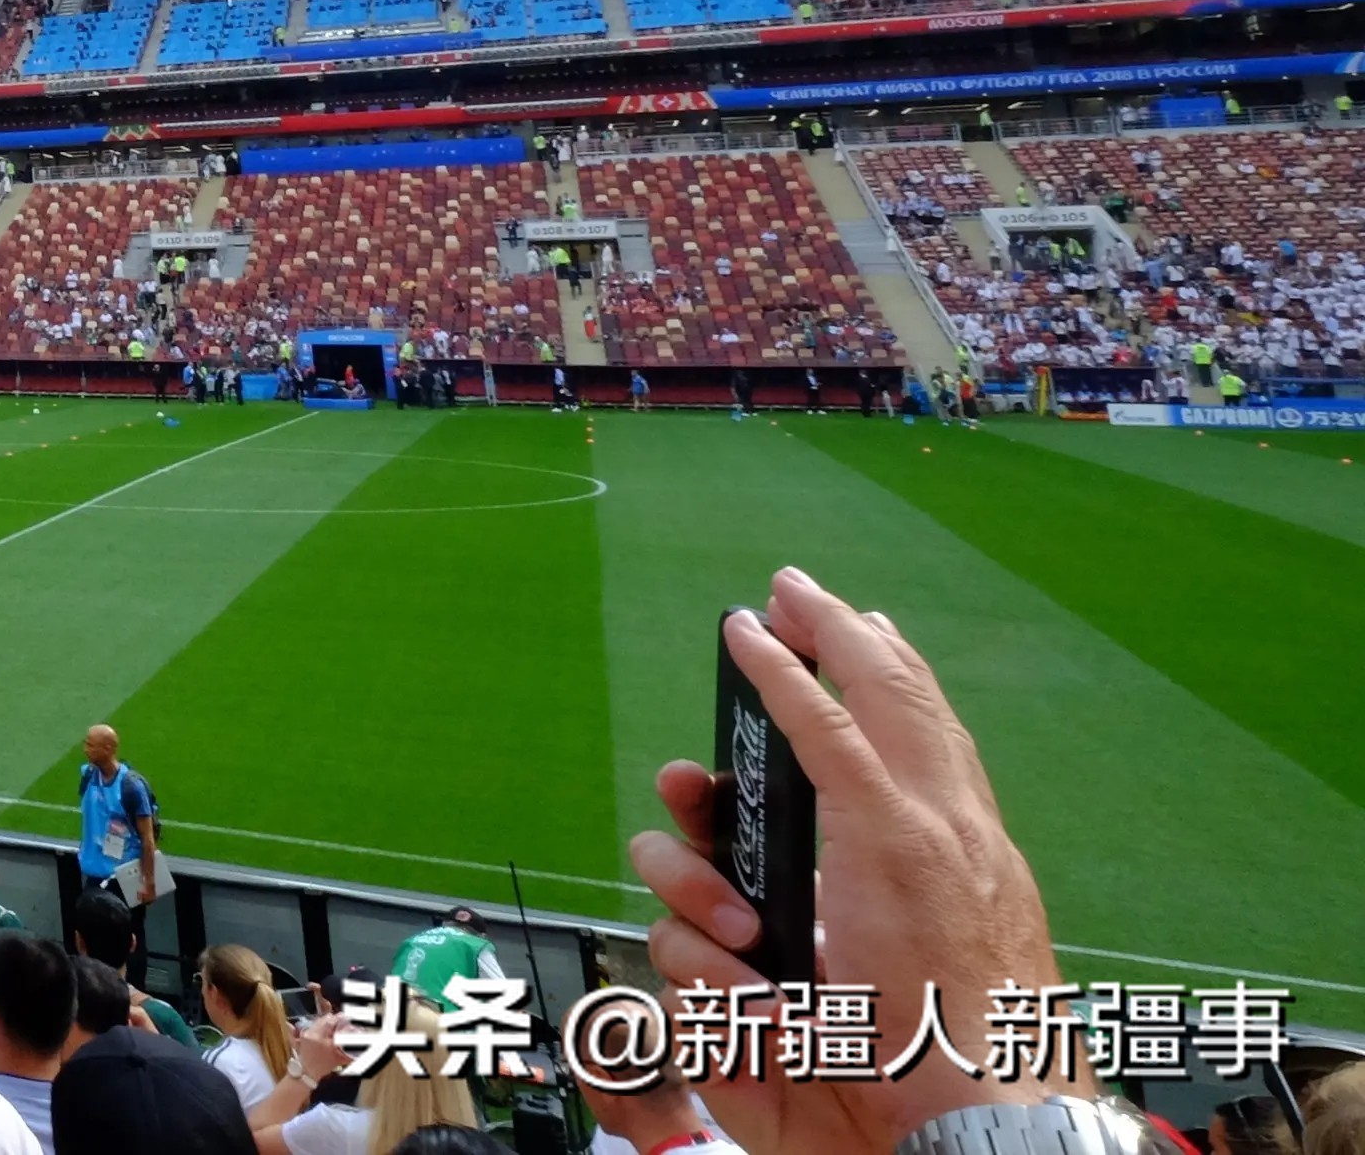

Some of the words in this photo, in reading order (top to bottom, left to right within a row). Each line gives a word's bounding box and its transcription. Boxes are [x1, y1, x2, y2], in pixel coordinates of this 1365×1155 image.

[927, 14, 1005, 31] MOSCOW
[770, 84, 871, 101] ЧЕМПИОНАТ
[876, 82, 927, 95] МИРА
[930, 79, 956, 92] ПО
[960, 74, 1043, 90] ФУТБОЛУ
[1048, 70, 1087, 85] FIFA
[1092, 68, 1134, 83] 2018
[1137, 67, 1152, 80] В
[1154, 63, 1236, 79] РОССИИ
[1181, 405, 1269, 427] GAZPROM
[758, 718, 768, 806] PARTNERS
[757, 813, 767, 900] EUROPEAN
